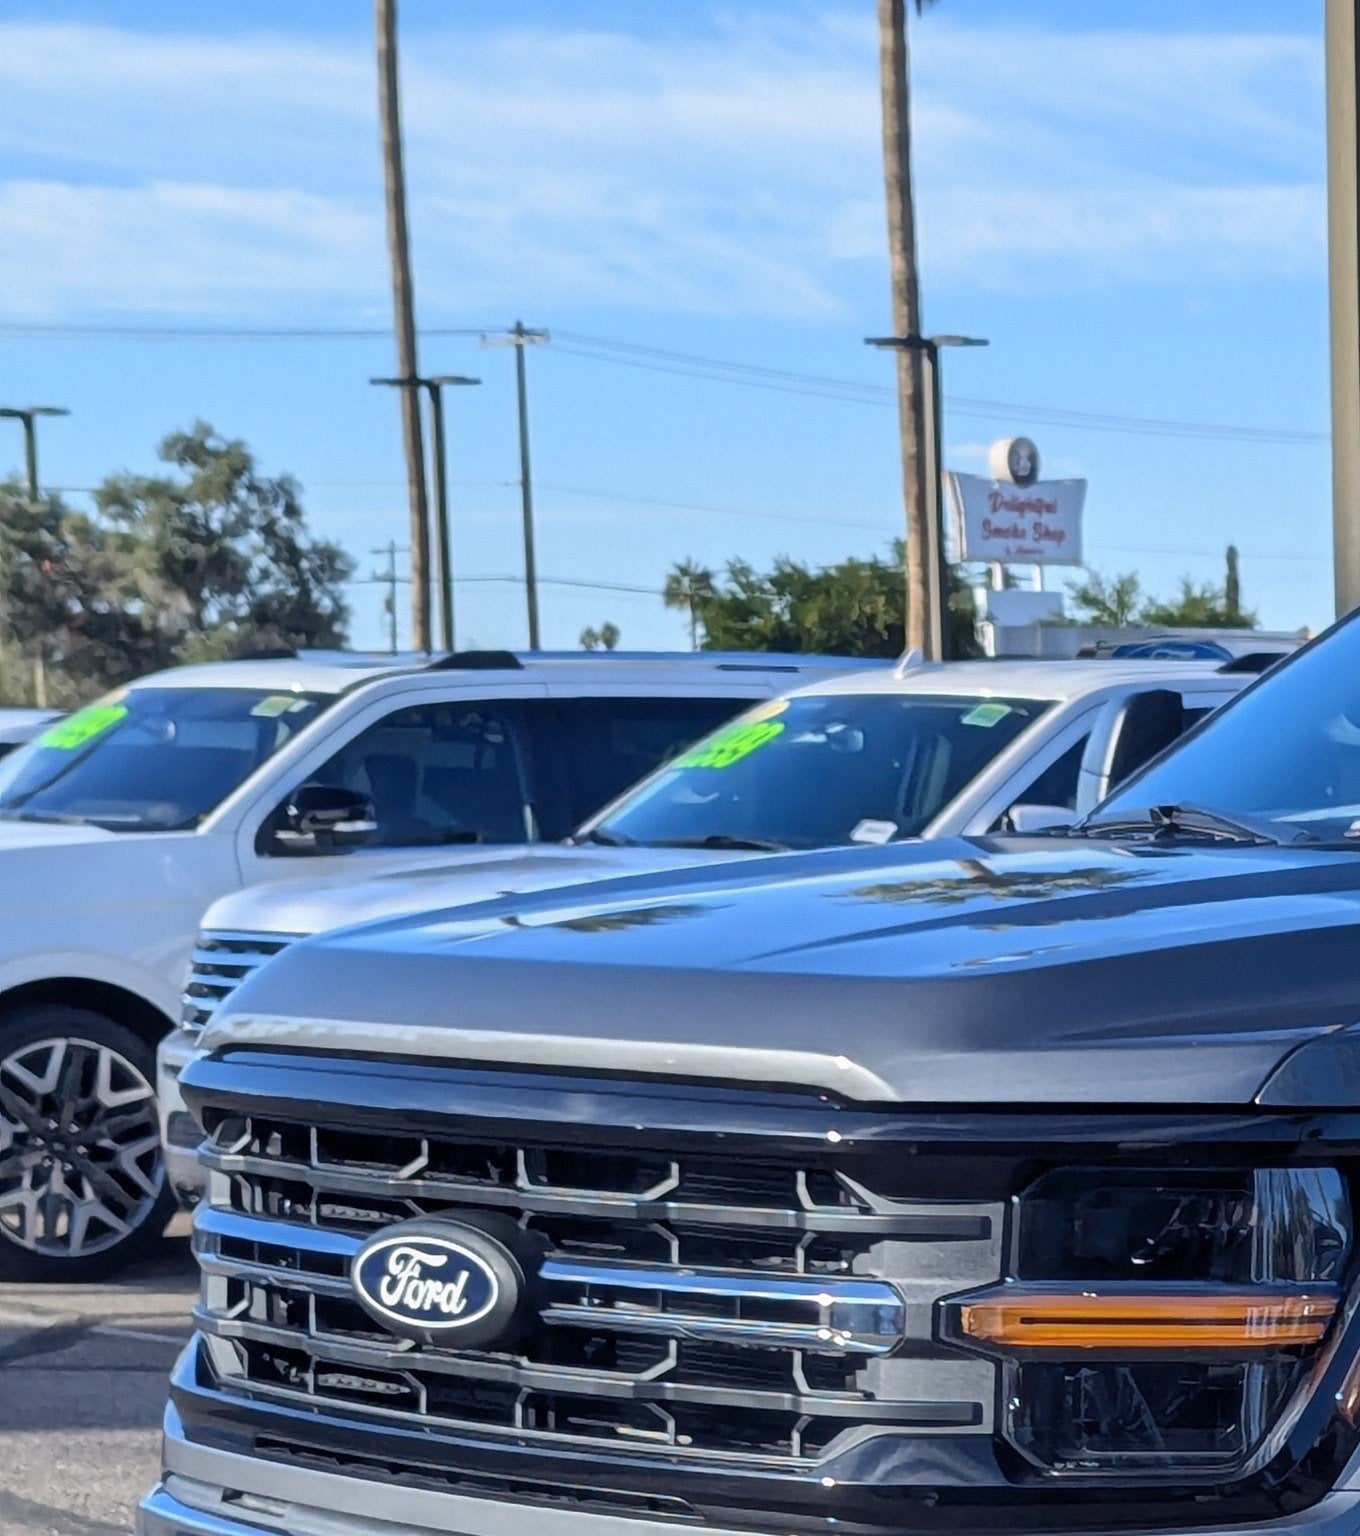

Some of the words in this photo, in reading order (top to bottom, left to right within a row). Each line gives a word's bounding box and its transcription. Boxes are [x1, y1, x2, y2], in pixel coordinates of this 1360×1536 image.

[982, 518, 1026, 540] Smoke
[1032, 521, 1065, 547] Shop
[380, 1246, 470, 1314] Ford
